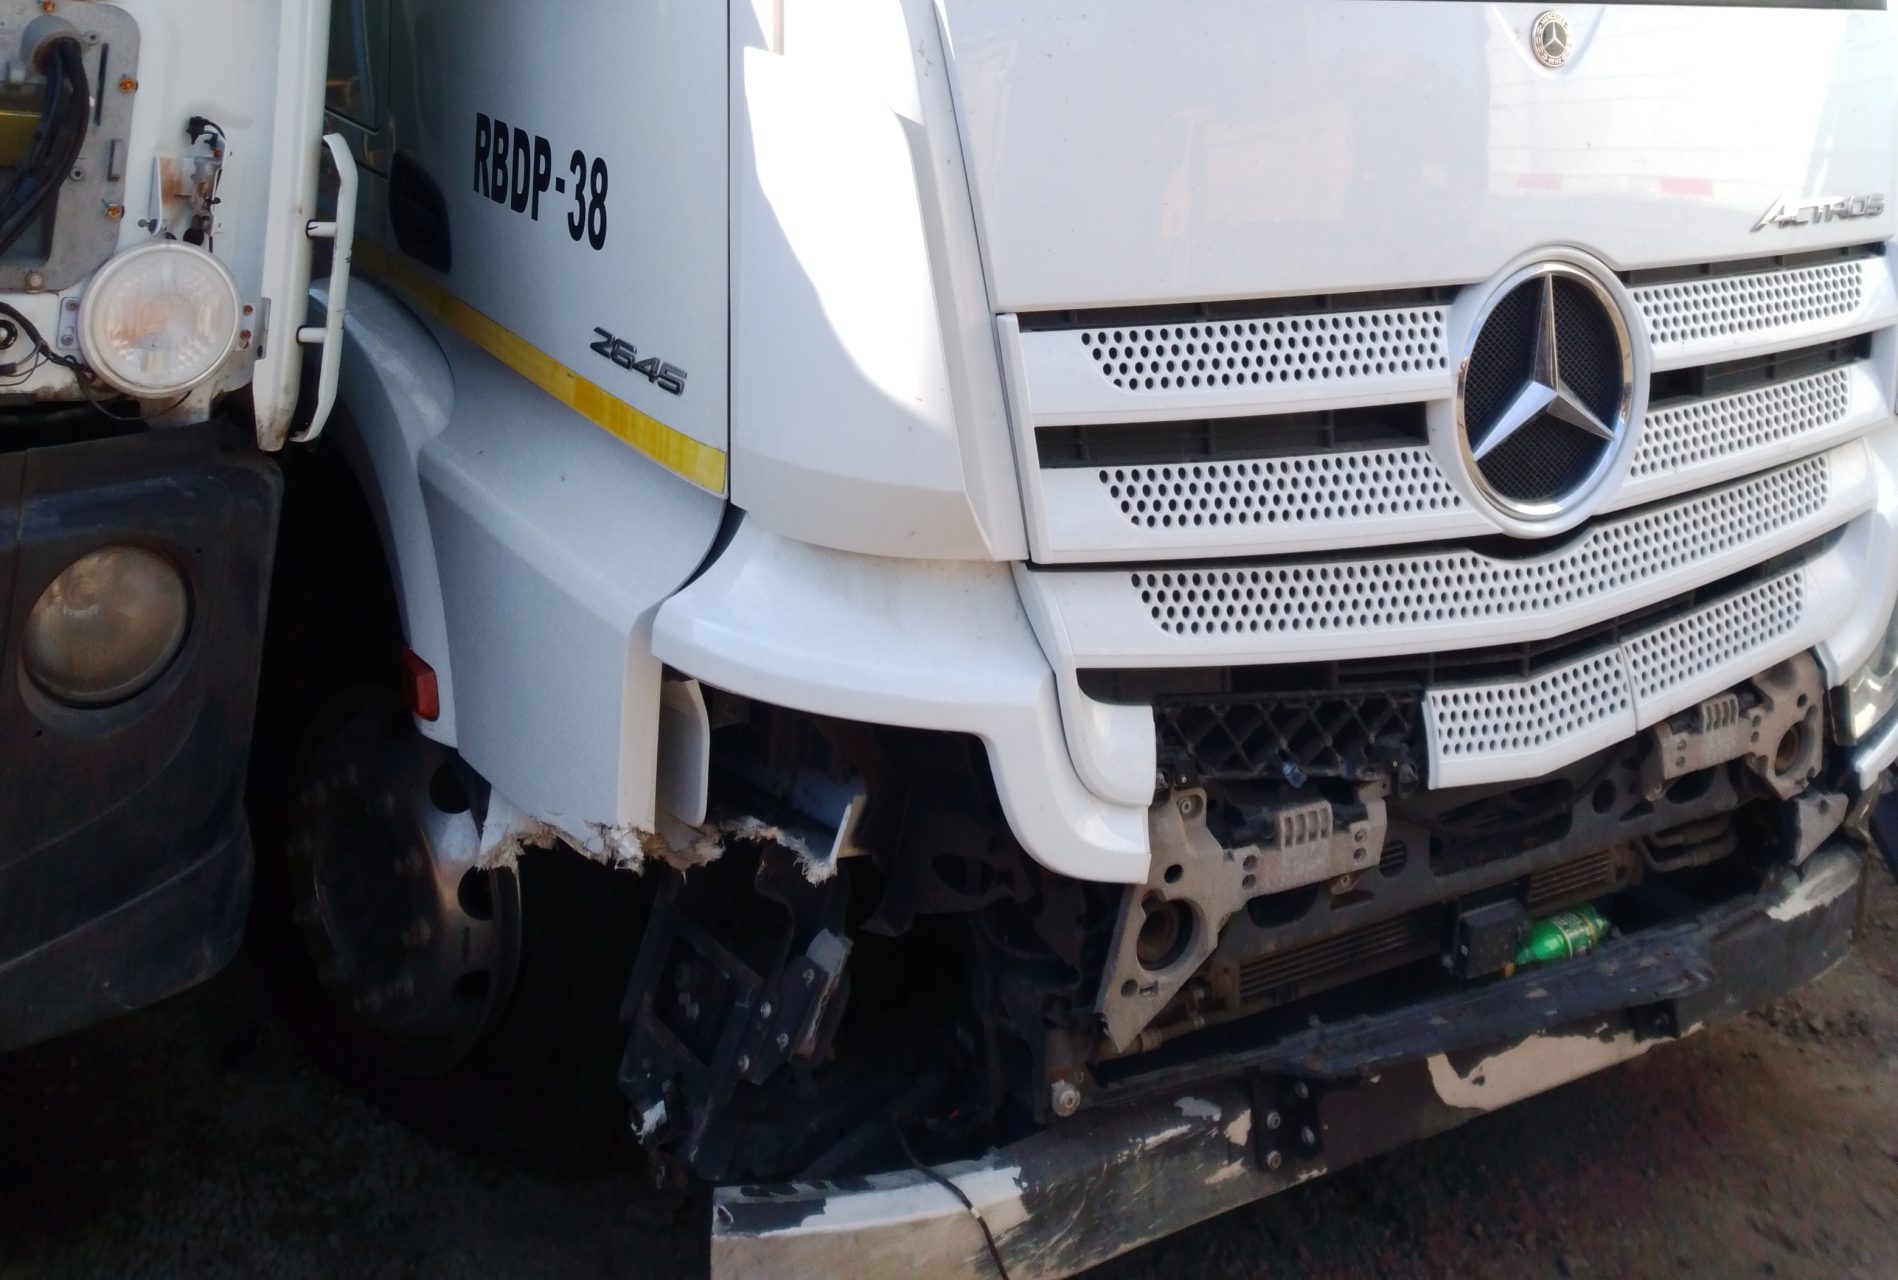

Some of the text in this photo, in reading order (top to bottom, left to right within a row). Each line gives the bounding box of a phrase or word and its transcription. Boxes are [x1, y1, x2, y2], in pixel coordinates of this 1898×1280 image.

[473, 111, 609, 251] RBDP-38
[1749, 192, 1886, 233] ACTROS
[589, 326, 688, 397] 2645
